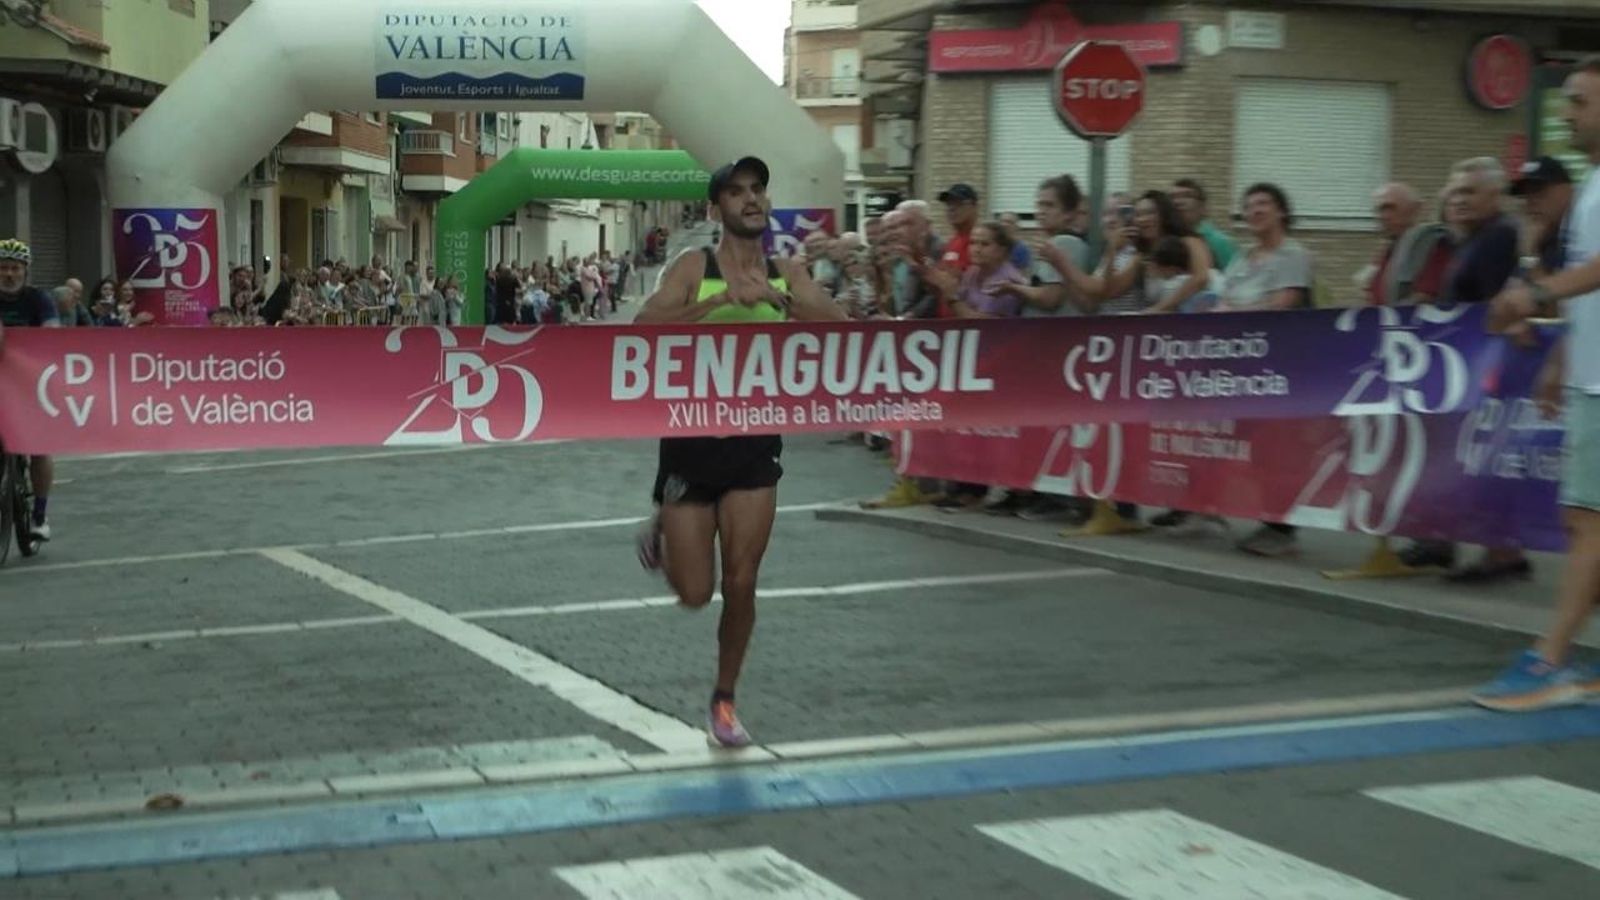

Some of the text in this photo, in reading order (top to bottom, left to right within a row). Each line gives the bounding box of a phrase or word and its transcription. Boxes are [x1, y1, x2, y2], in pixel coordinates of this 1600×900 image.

[540, 15, 572, 28] DE
[385, 30, 576, 61] VALÈNCIA
[457, 83, 504, 97] Esports
[1065, 78, 1139, 99] STOP
[610, 329, 994, 400] BENAGUASIL
[1140, 331, 1270, 366] Diputació
[130, 351, 285, 389] Diputació
[1137, 368, 1290, 400] de València
[132, 393, 314, 426] de València
[668, 396, 944, 431] XVII Pujada a la Montieleta
